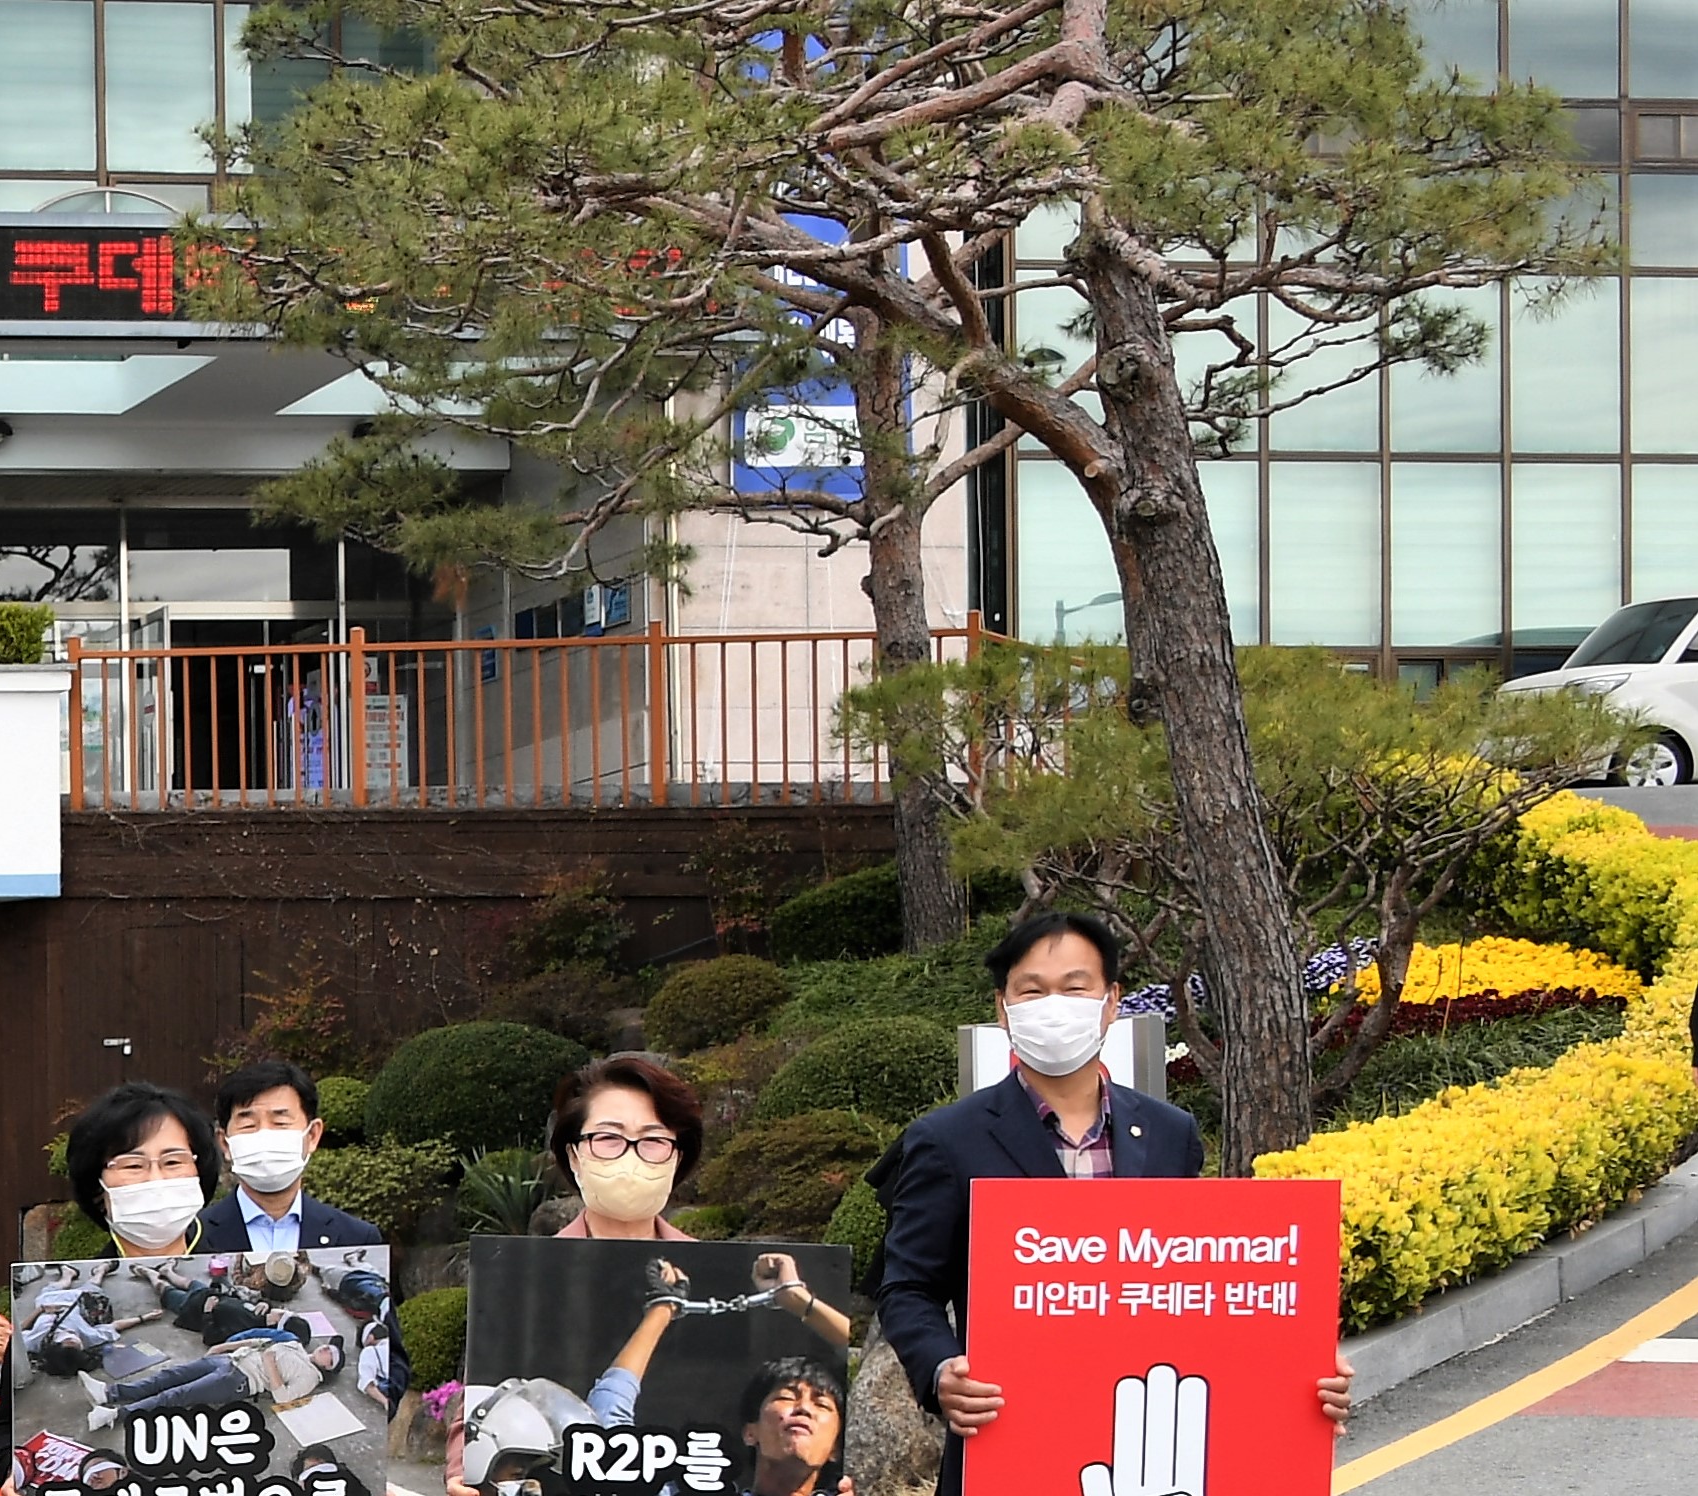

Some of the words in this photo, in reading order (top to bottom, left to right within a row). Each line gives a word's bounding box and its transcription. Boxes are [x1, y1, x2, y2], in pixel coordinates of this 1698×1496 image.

[1015, 1228, 1106, 1263] Save
[1119, 1225, 1297, 1268] Myanmar!
[1015, 1282, 1110, 1315] 미얀마
[1118, 1282, 1215, 1315] 쿠테타
[1226, 1282, 1296, 1315] 반대!
[134, 1410, 260, 1464] UN은
[572, 1432, 731, 1490] R2P를
